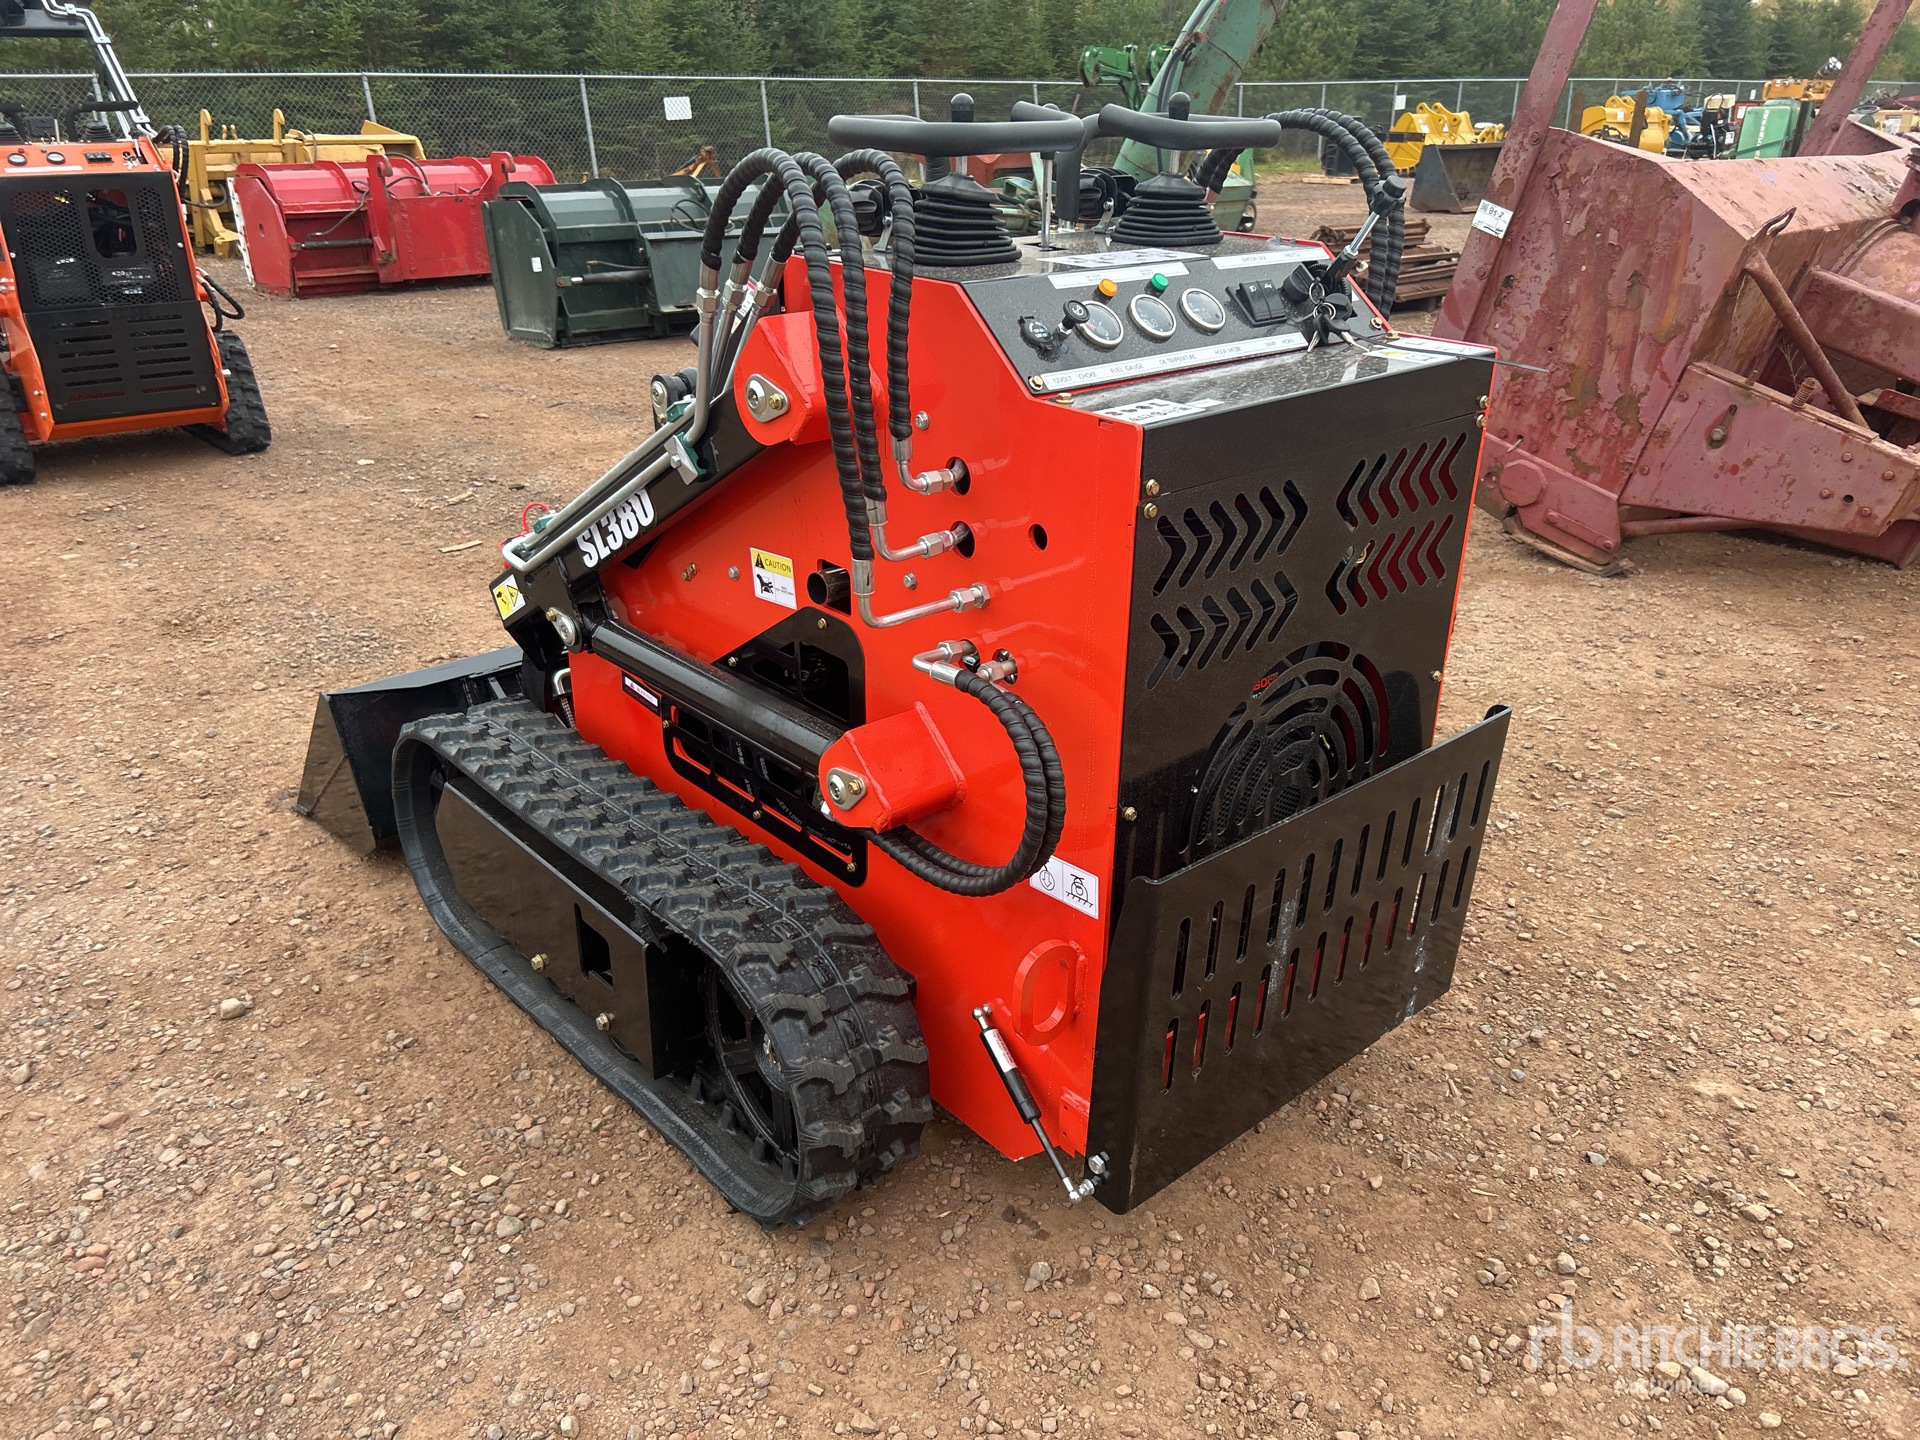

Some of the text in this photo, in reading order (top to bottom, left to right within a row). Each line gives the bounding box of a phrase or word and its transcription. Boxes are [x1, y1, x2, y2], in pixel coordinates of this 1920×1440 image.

[1124, 363, 1144, 372] GAUGE
[1052, 375, 1073, 384] 12VOLT
[1078, 371, 1098, 380] CHOKE
[576, 488, 655, 568] SL380
[764, 558, 792, 573] CAUTION
